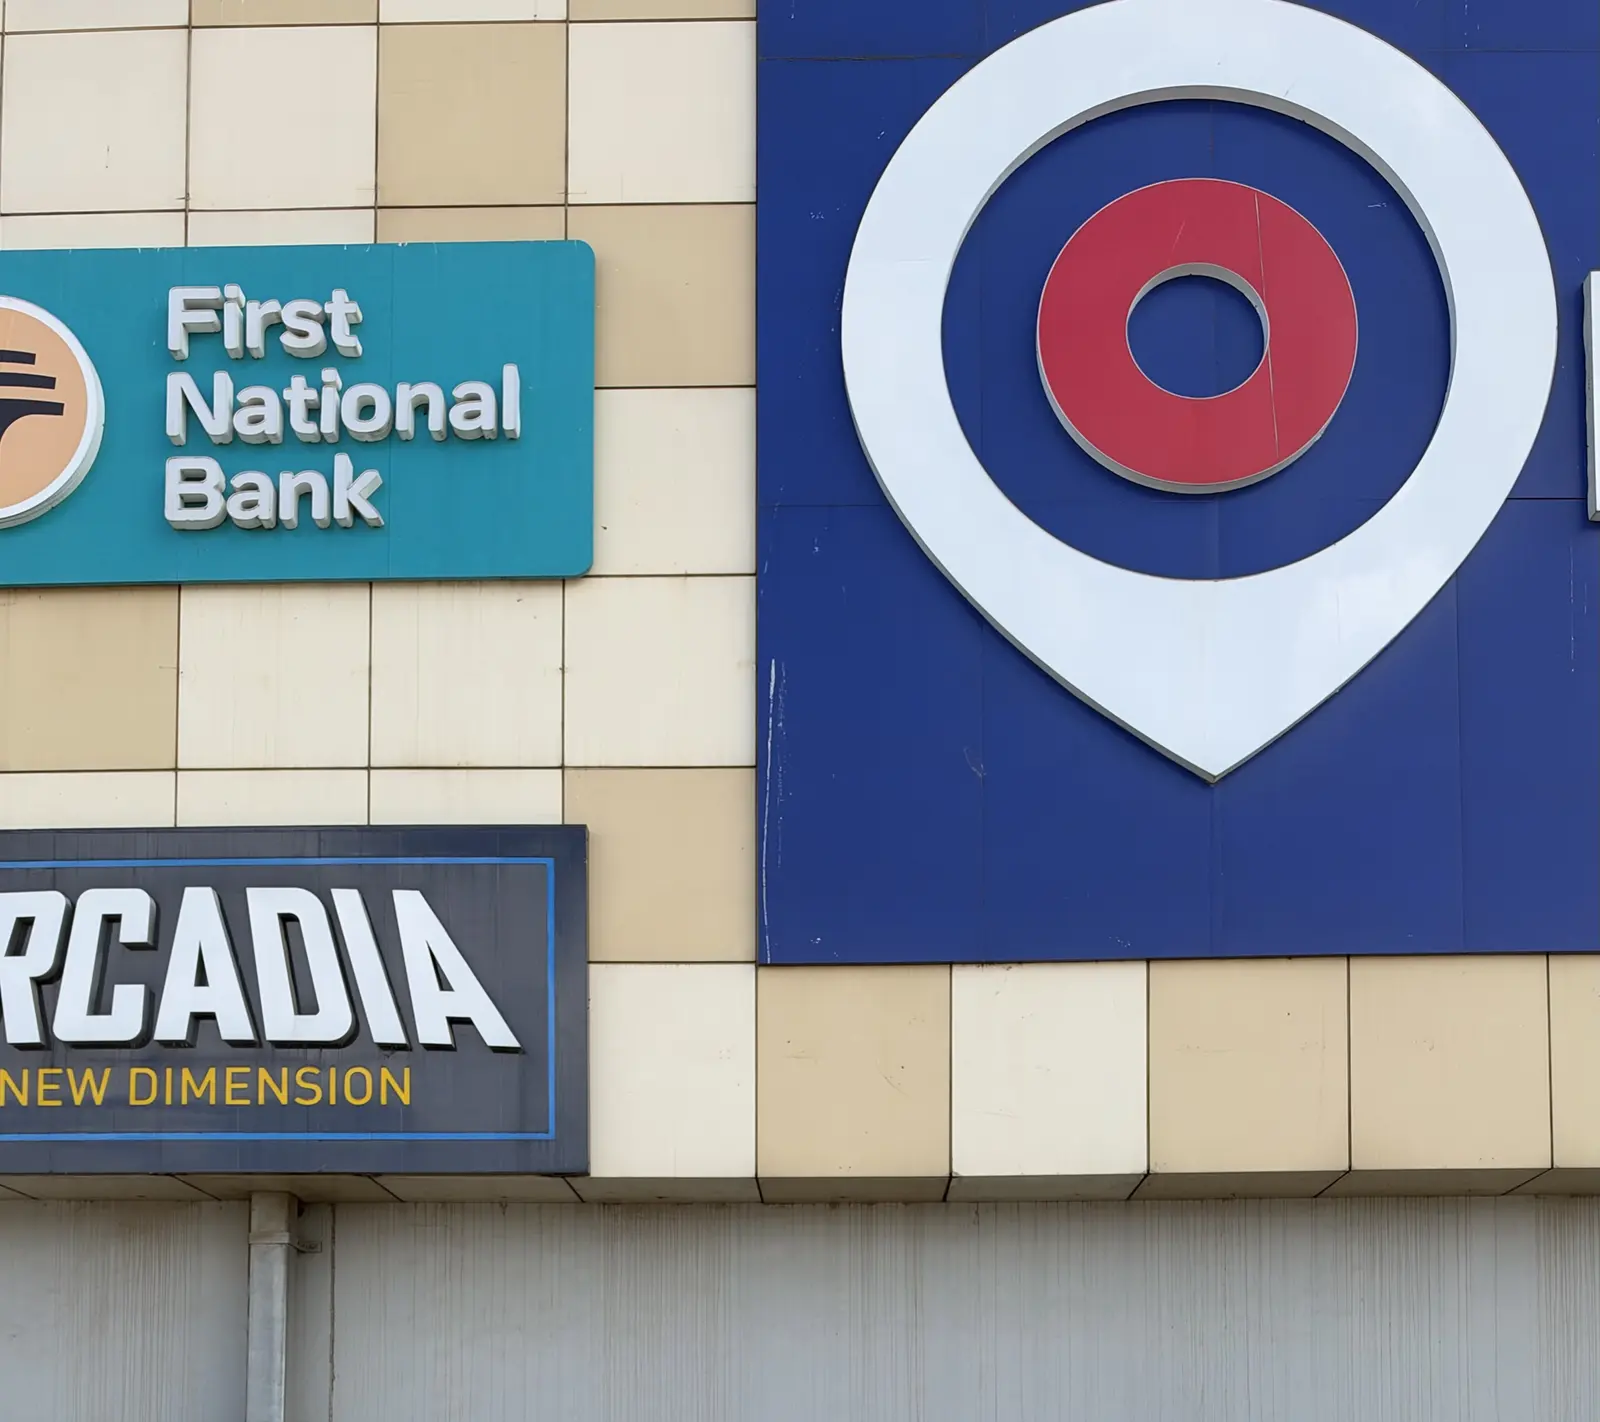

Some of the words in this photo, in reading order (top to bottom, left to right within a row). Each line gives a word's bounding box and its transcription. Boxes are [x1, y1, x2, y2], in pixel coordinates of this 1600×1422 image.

[167, 283, 363, 361] First
[166, 363, 521, 446] National
[164, 452, 385, 531] Bank
[0, 1067, 112, 1107] NEW
[129, 1066, 412, 1106] DIMENSION
